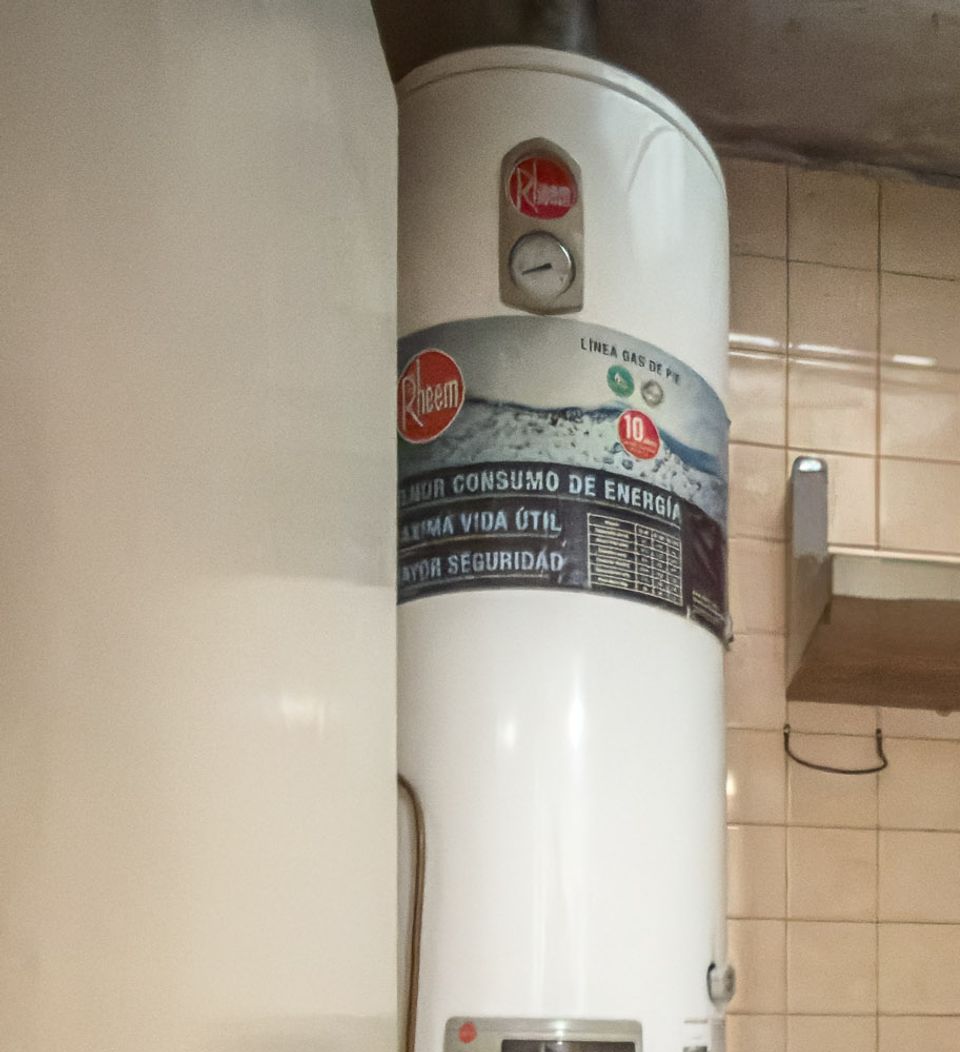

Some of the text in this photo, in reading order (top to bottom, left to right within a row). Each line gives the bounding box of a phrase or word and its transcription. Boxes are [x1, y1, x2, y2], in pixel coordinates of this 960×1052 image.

[622, 350, 646, 368] GAS
[649, 360, 663, 376] DE
[402, 358, 459, 431] Rheem
[624, 414, 644, 442] 10
[398, 470, 682, 522] NOR CONSUMO DE ENERGÍA
[401, 507, 562, 541] XIMA VIDA ÚTIL
[402, 551, 565, 582] AYOR SEGURIDAD
